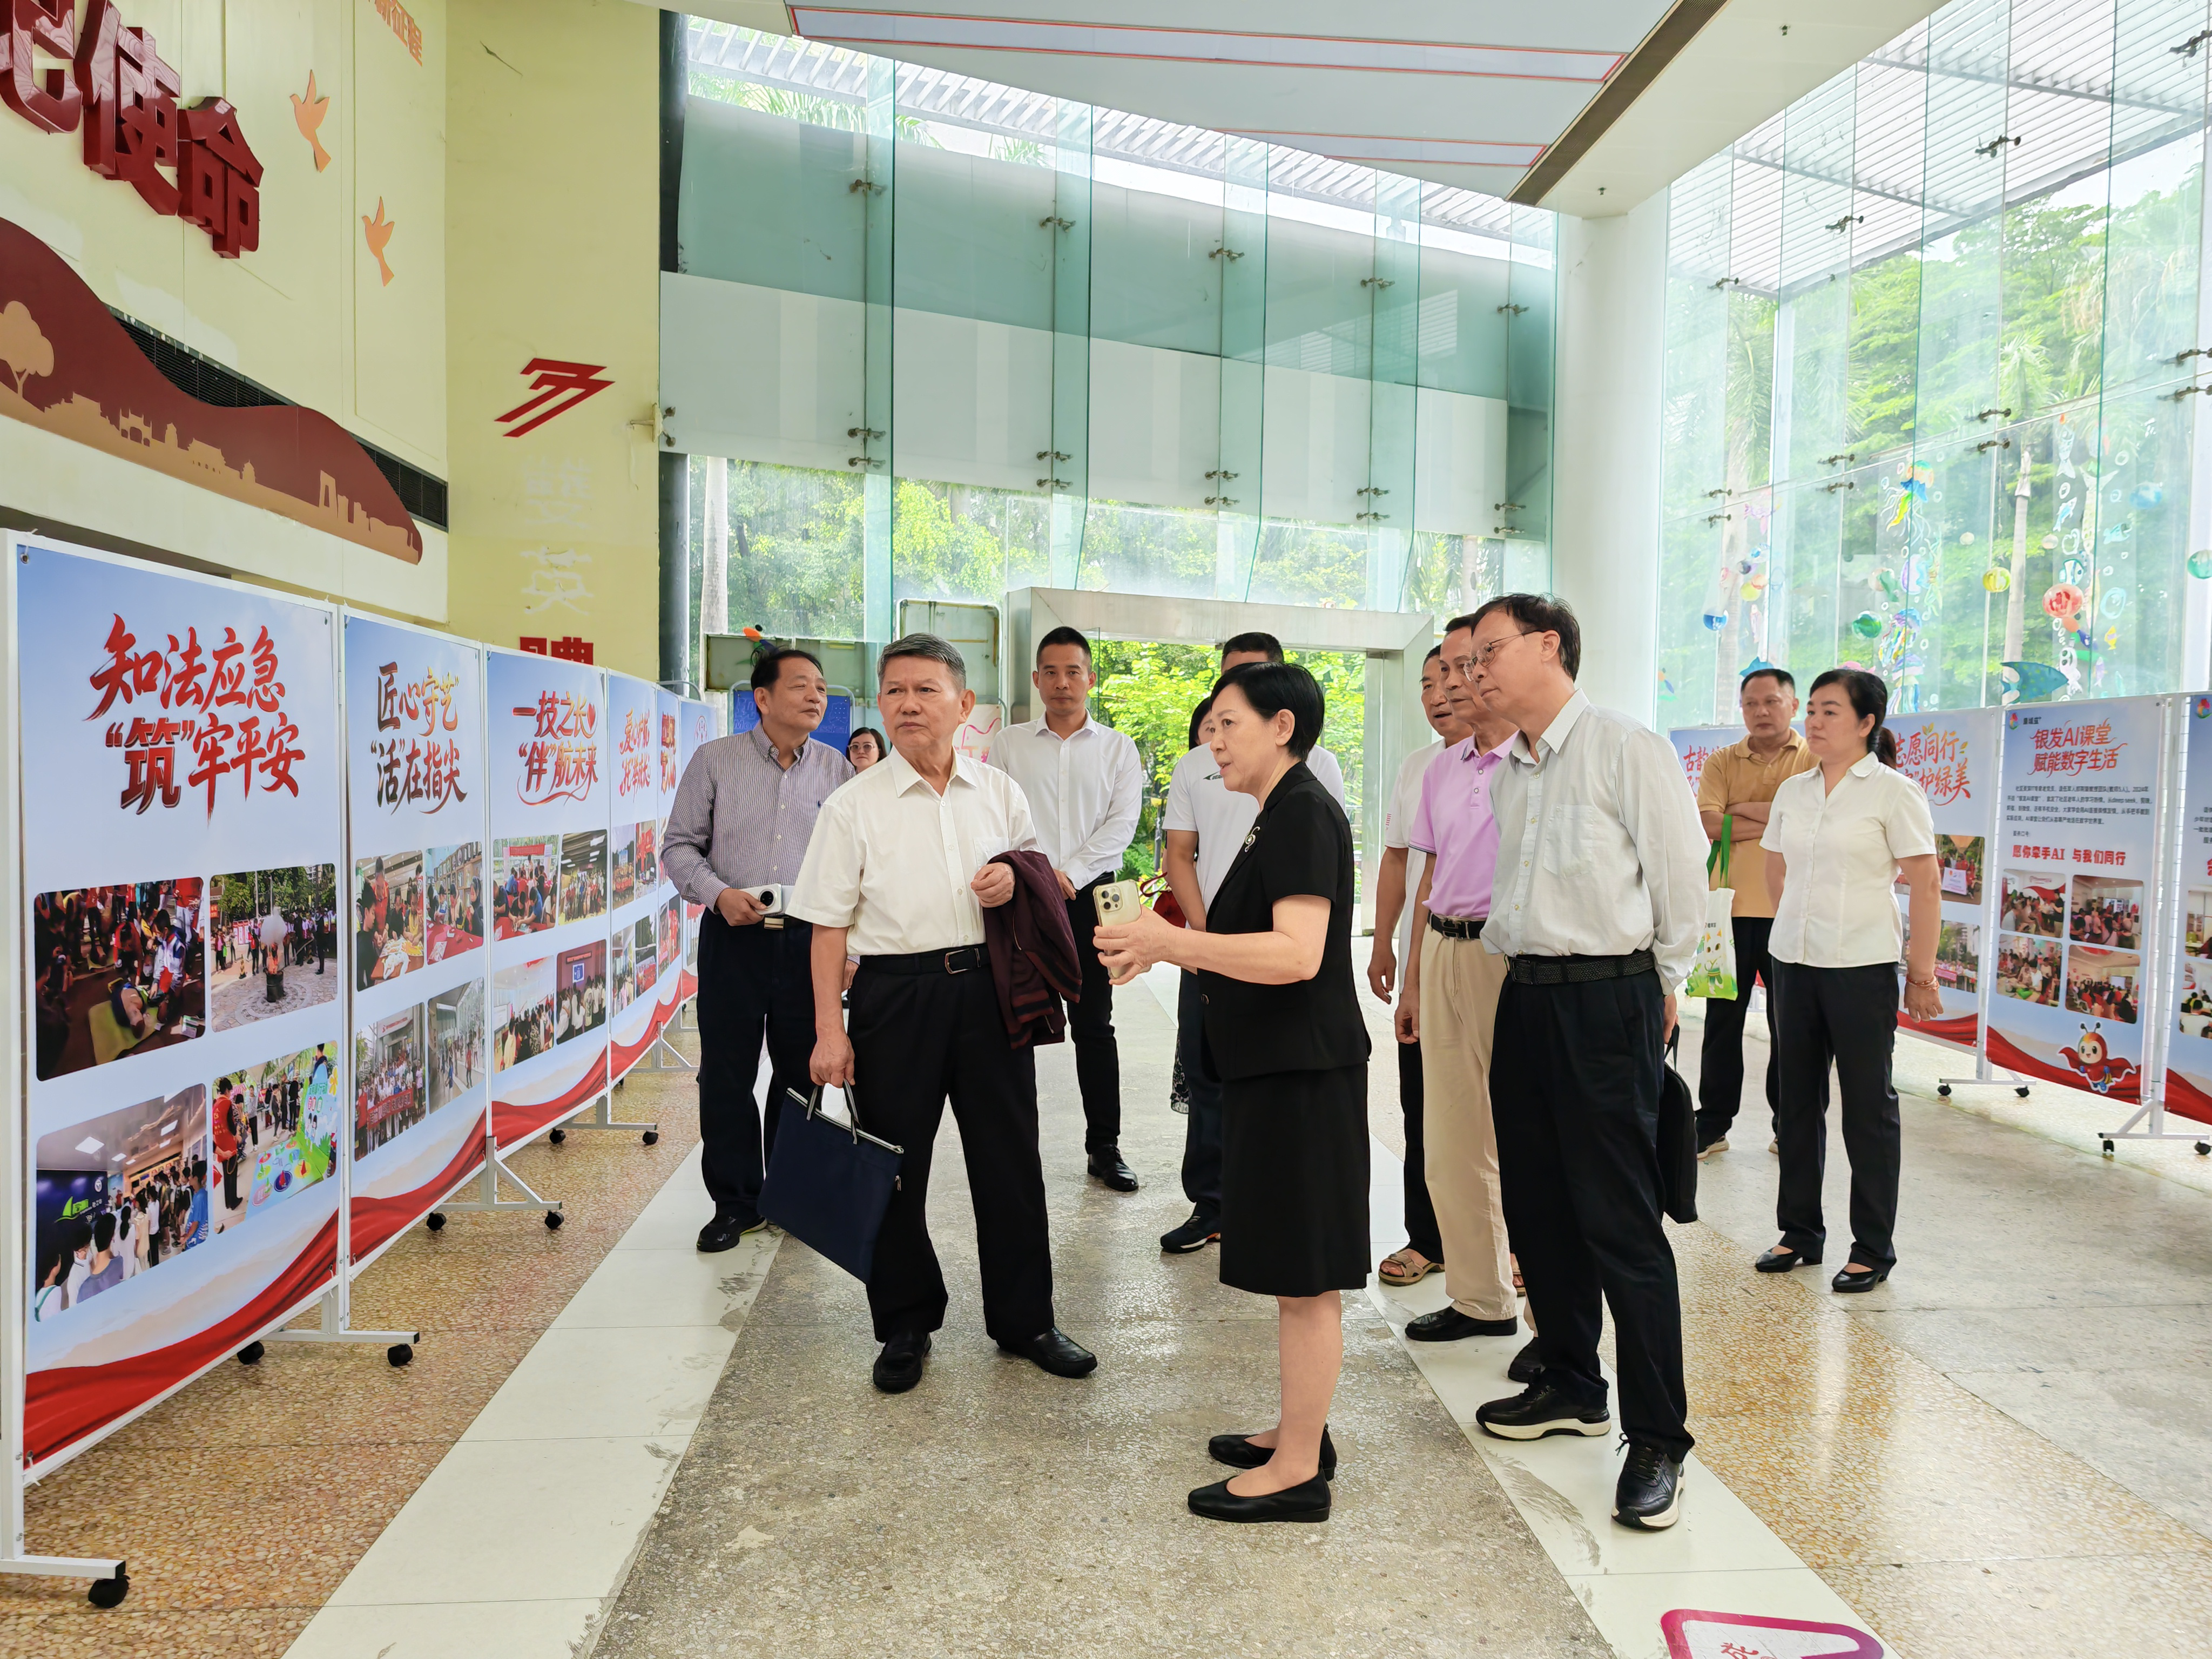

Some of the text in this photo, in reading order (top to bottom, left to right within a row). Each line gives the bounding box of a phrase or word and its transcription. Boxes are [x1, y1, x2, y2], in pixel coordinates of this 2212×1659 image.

[84, 613, 286, 721] 知法应急
[512, 691, 598, 740] 一技之长
[2030, 718, 2117, 750] 银发AI课堂
[105, 712, 306, 828] “筑”牢平安
[517, 739, 598, 806] “伴”航未来
[1683, 745, 1719, 772] 古韵
[1896, 730, 1959, 768] 志愿同行
[2027, 743, 2128, 778] 赋能数字生活
[371, 738, 468, 815] “活”在指尖
[1904, 758, 1971, 806] ”护绿美
[2013, 845, 2126, 866] 愿你牵手AI 与我们同行
